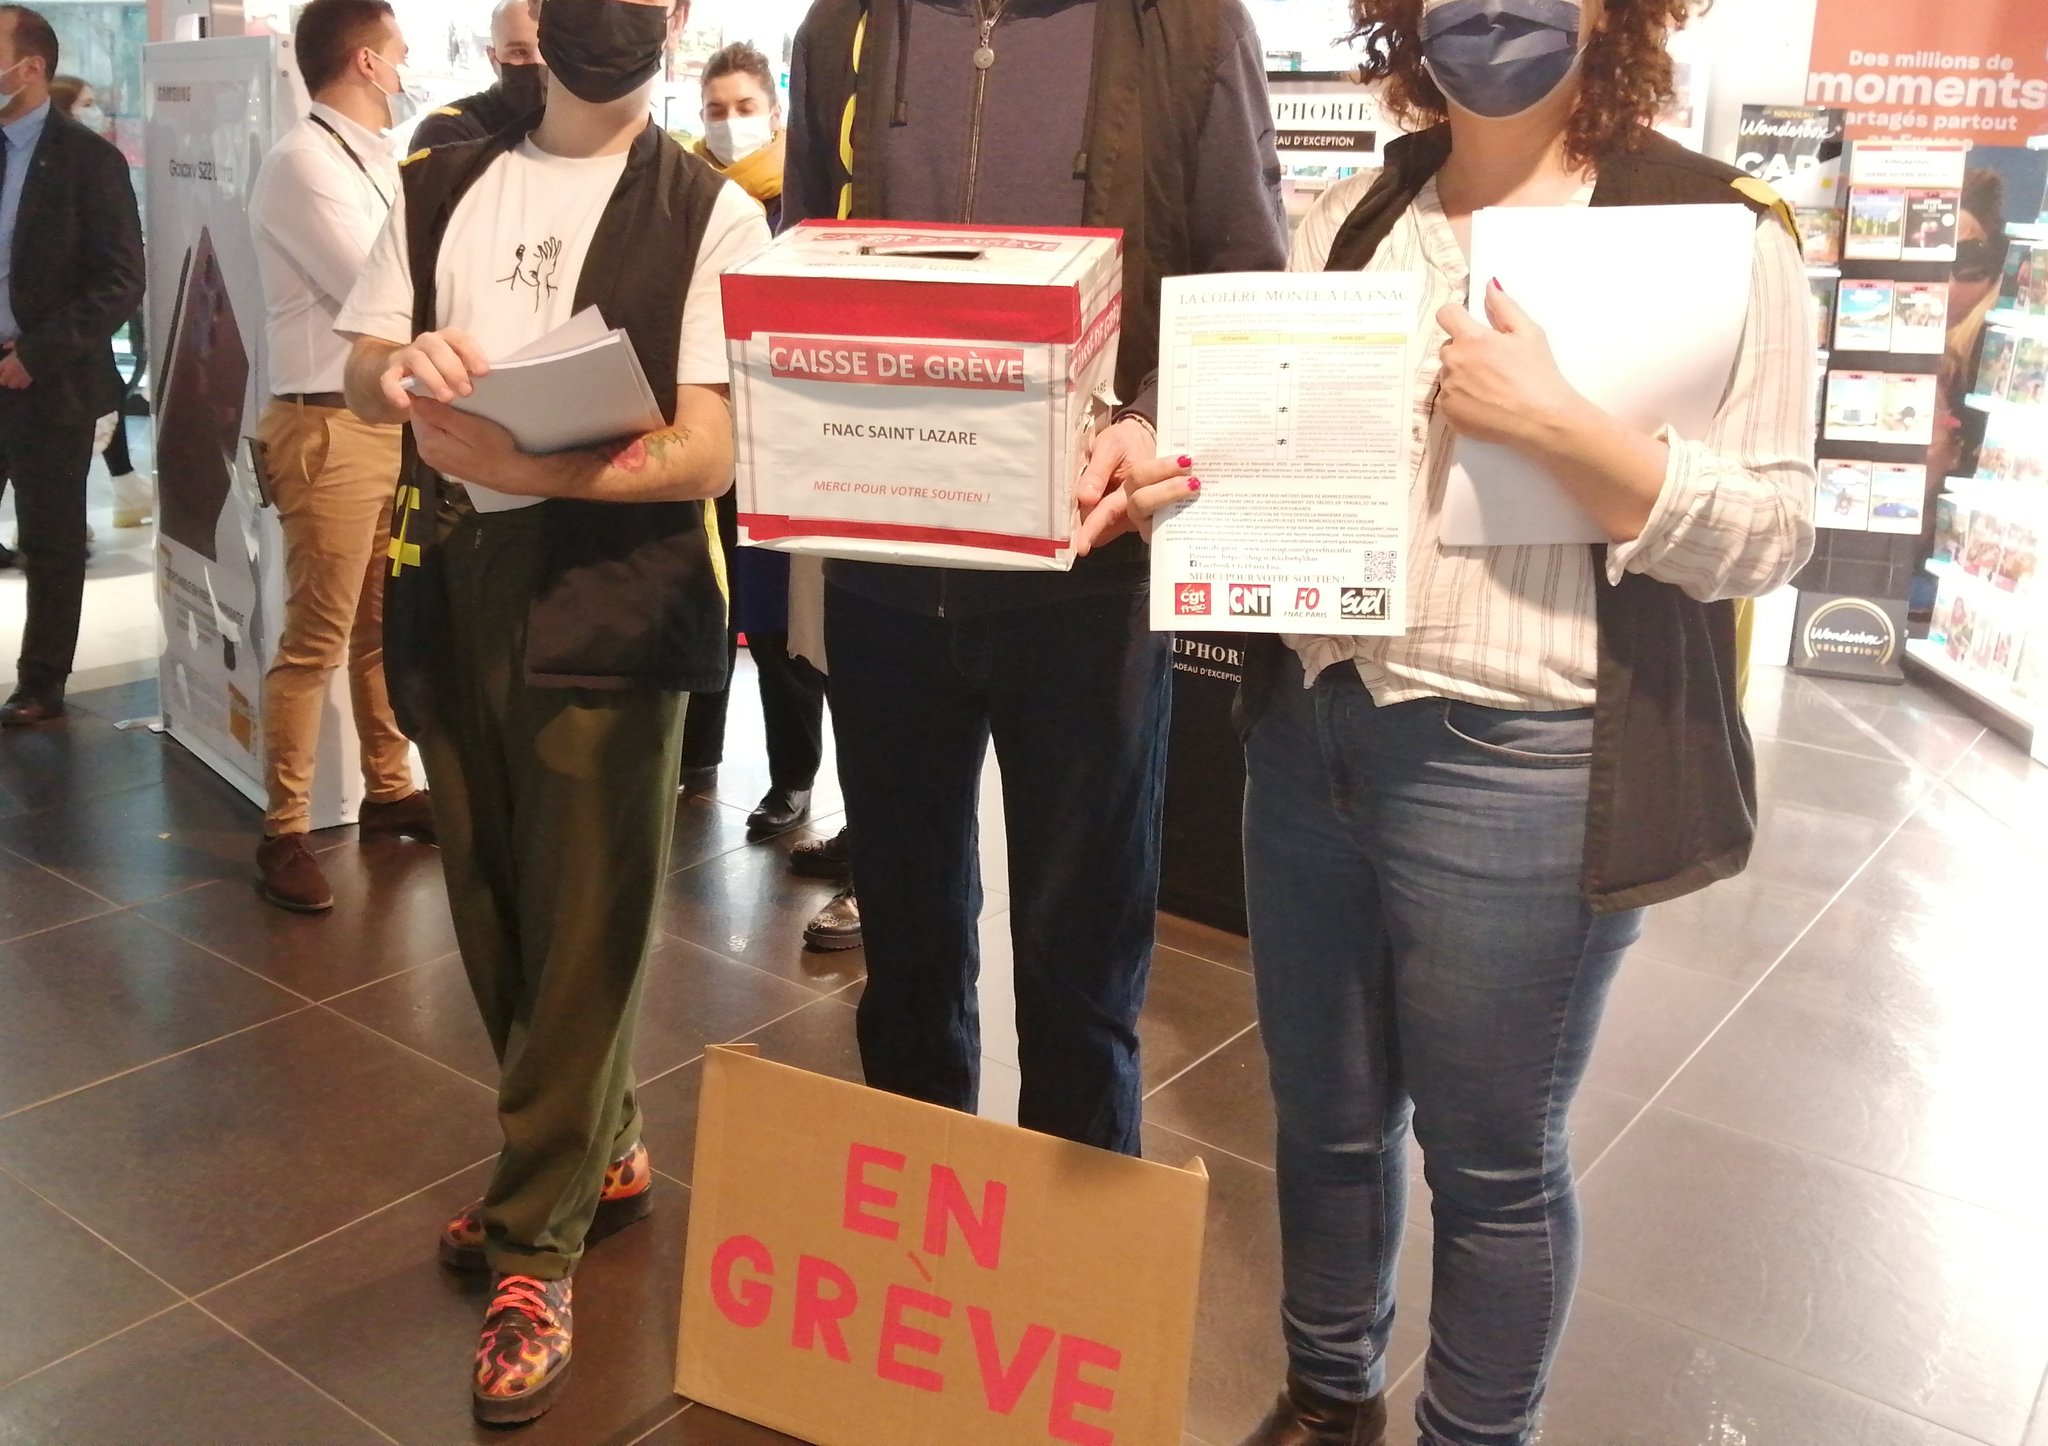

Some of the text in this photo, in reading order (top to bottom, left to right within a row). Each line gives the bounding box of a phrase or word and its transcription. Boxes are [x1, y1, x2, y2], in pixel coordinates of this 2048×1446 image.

[1849, 49, 2014, 71] Des millions de
[1806, 72, 2048, 110] moments
[1276, 102, 1372, 121] PHORIE
[1845, 109, 2018, 131] artagés partout
[1274, 136, 1354, 147] EAU D'EXCEPTION
[1179, 293, 1197, 305] LA
[1265, 290, 1321, 302] MONTE
[1343, 290, 1363, 302] LA
[1367, 290, 1407, 302] FNAC
[770, 347, 1024, 385] CAISSE DE GRÈVE
[822, 423, 977, 446] FNAC SAINT LAZARE
[813, 480, 991, 503] MERCI POUR VOTRE SOUTIEN !
[1189, 572, 1223, 582] MERCI
[1226, 573, 1254, 582] POUR
[1256, 574, 1289, 583] VOTRE
[1292, 574, 1341, 584] SOUTIEN
[1180, 588, 1206, 605] cgt
[1229, 587, 1269, 615] CNT
[1294, 586, 1320, 610] FO
[1283, 611, 1328, 619] FNAC PARIS
[1810, 626, 1885, 646] Wonderbox
[1172, 637, 1245, 667] UPHORI
[1172, 662, 1242, 683] ADEAU D'EXCEPTIO
[843, 1142, 1008, 1271] EN
[710, 1234, 1122, 1446] GRÈVE
